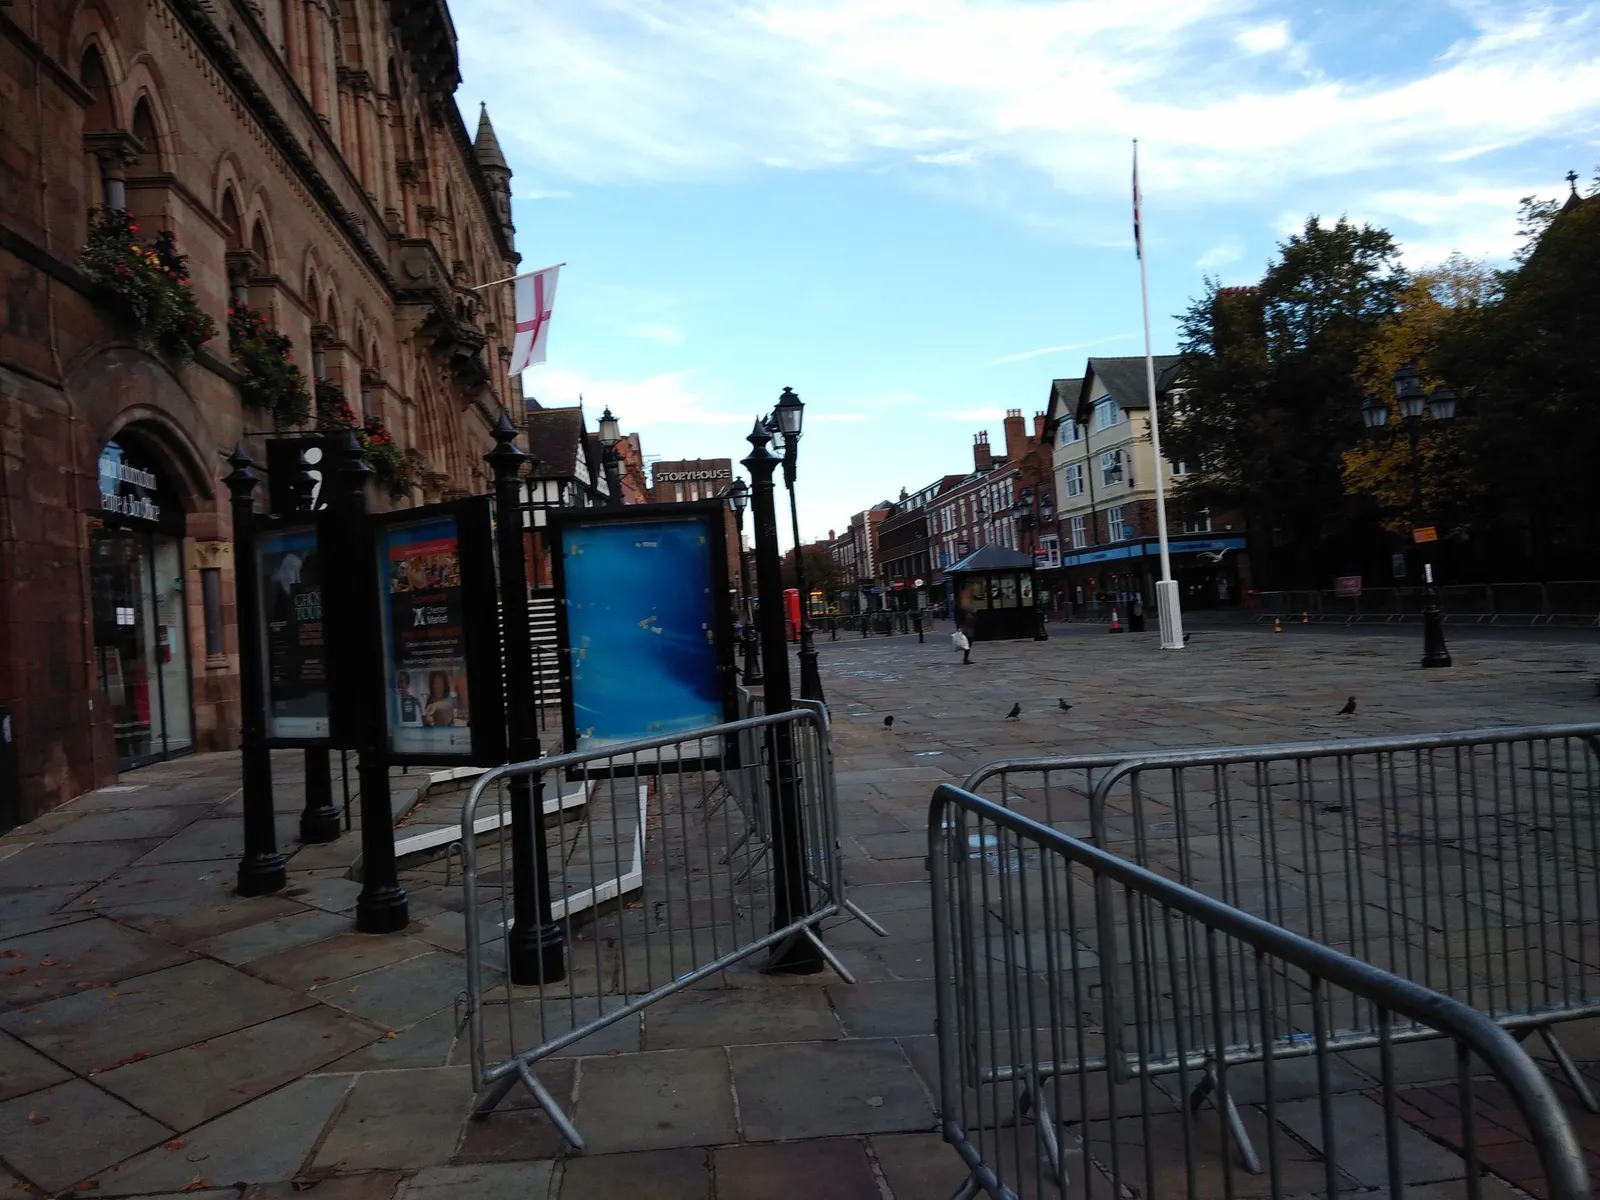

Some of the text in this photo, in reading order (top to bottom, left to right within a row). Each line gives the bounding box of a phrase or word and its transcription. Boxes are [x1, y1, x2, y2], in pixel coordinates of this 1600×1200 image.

[117, 456, 157, 491] Information
[656, 469, 730, 482] STORYHOUSE
[101, 492, 160, 522] entre & Box Office
[295, 591, 322, 607] GHOS
[426, 605, 448, 615] Chester
[426, 614, 448, 625] Market
